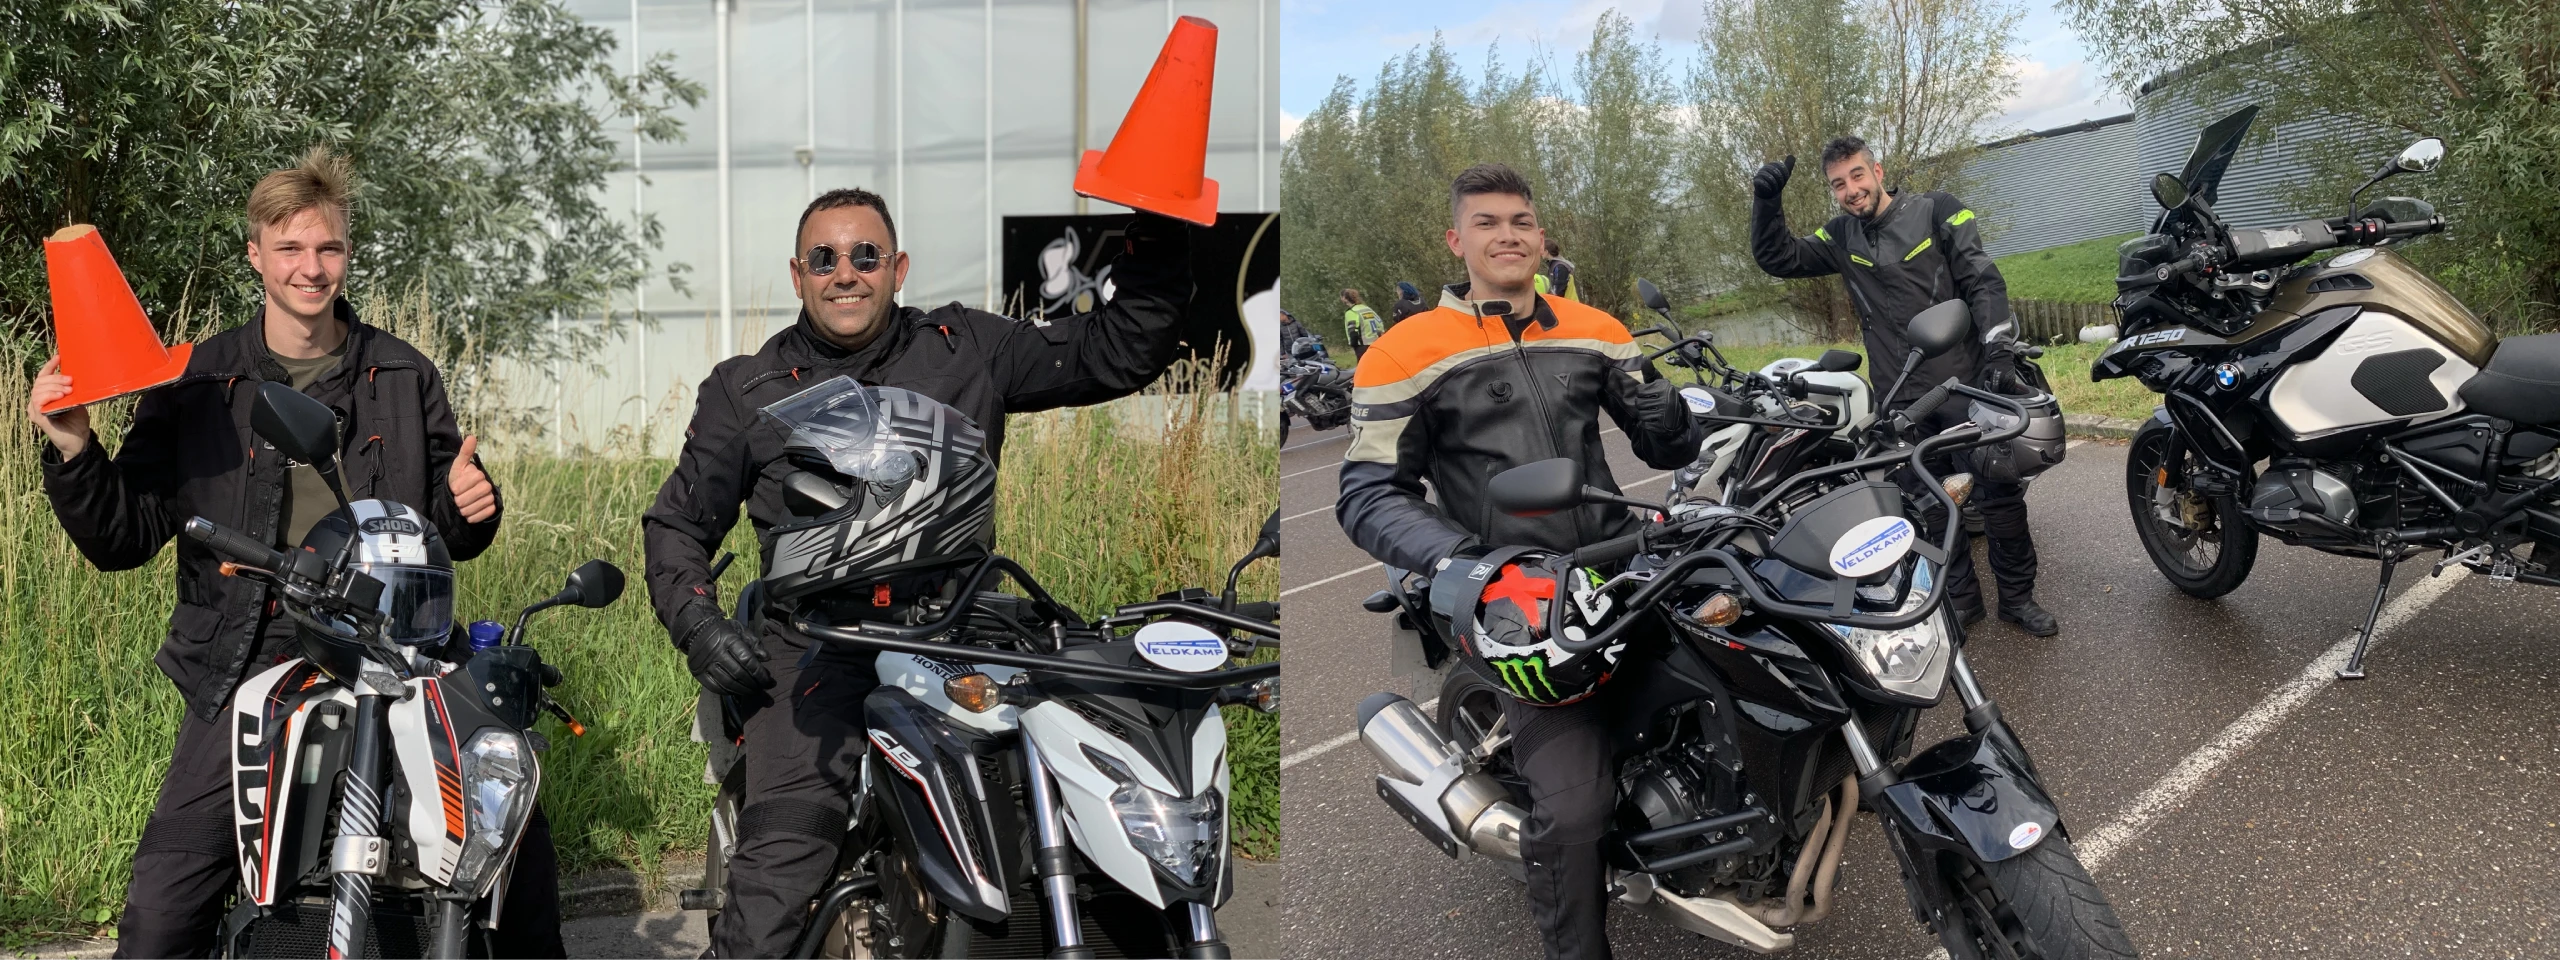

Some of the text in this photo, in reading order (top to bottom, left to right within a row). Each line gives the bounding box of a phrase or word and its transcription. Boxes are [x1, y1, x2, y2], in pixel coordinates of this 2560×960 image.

[2123, 328, 2186, 350] R1250
[2337, 330, 2393, 355] GS
[368, 519, 416, 533] SHOEI
[1835, 527, 1911, 570] VELDKAMP
[1139, 641, 1224, 656] VELDKAMP
[911, 654, 953, 681] HOND
